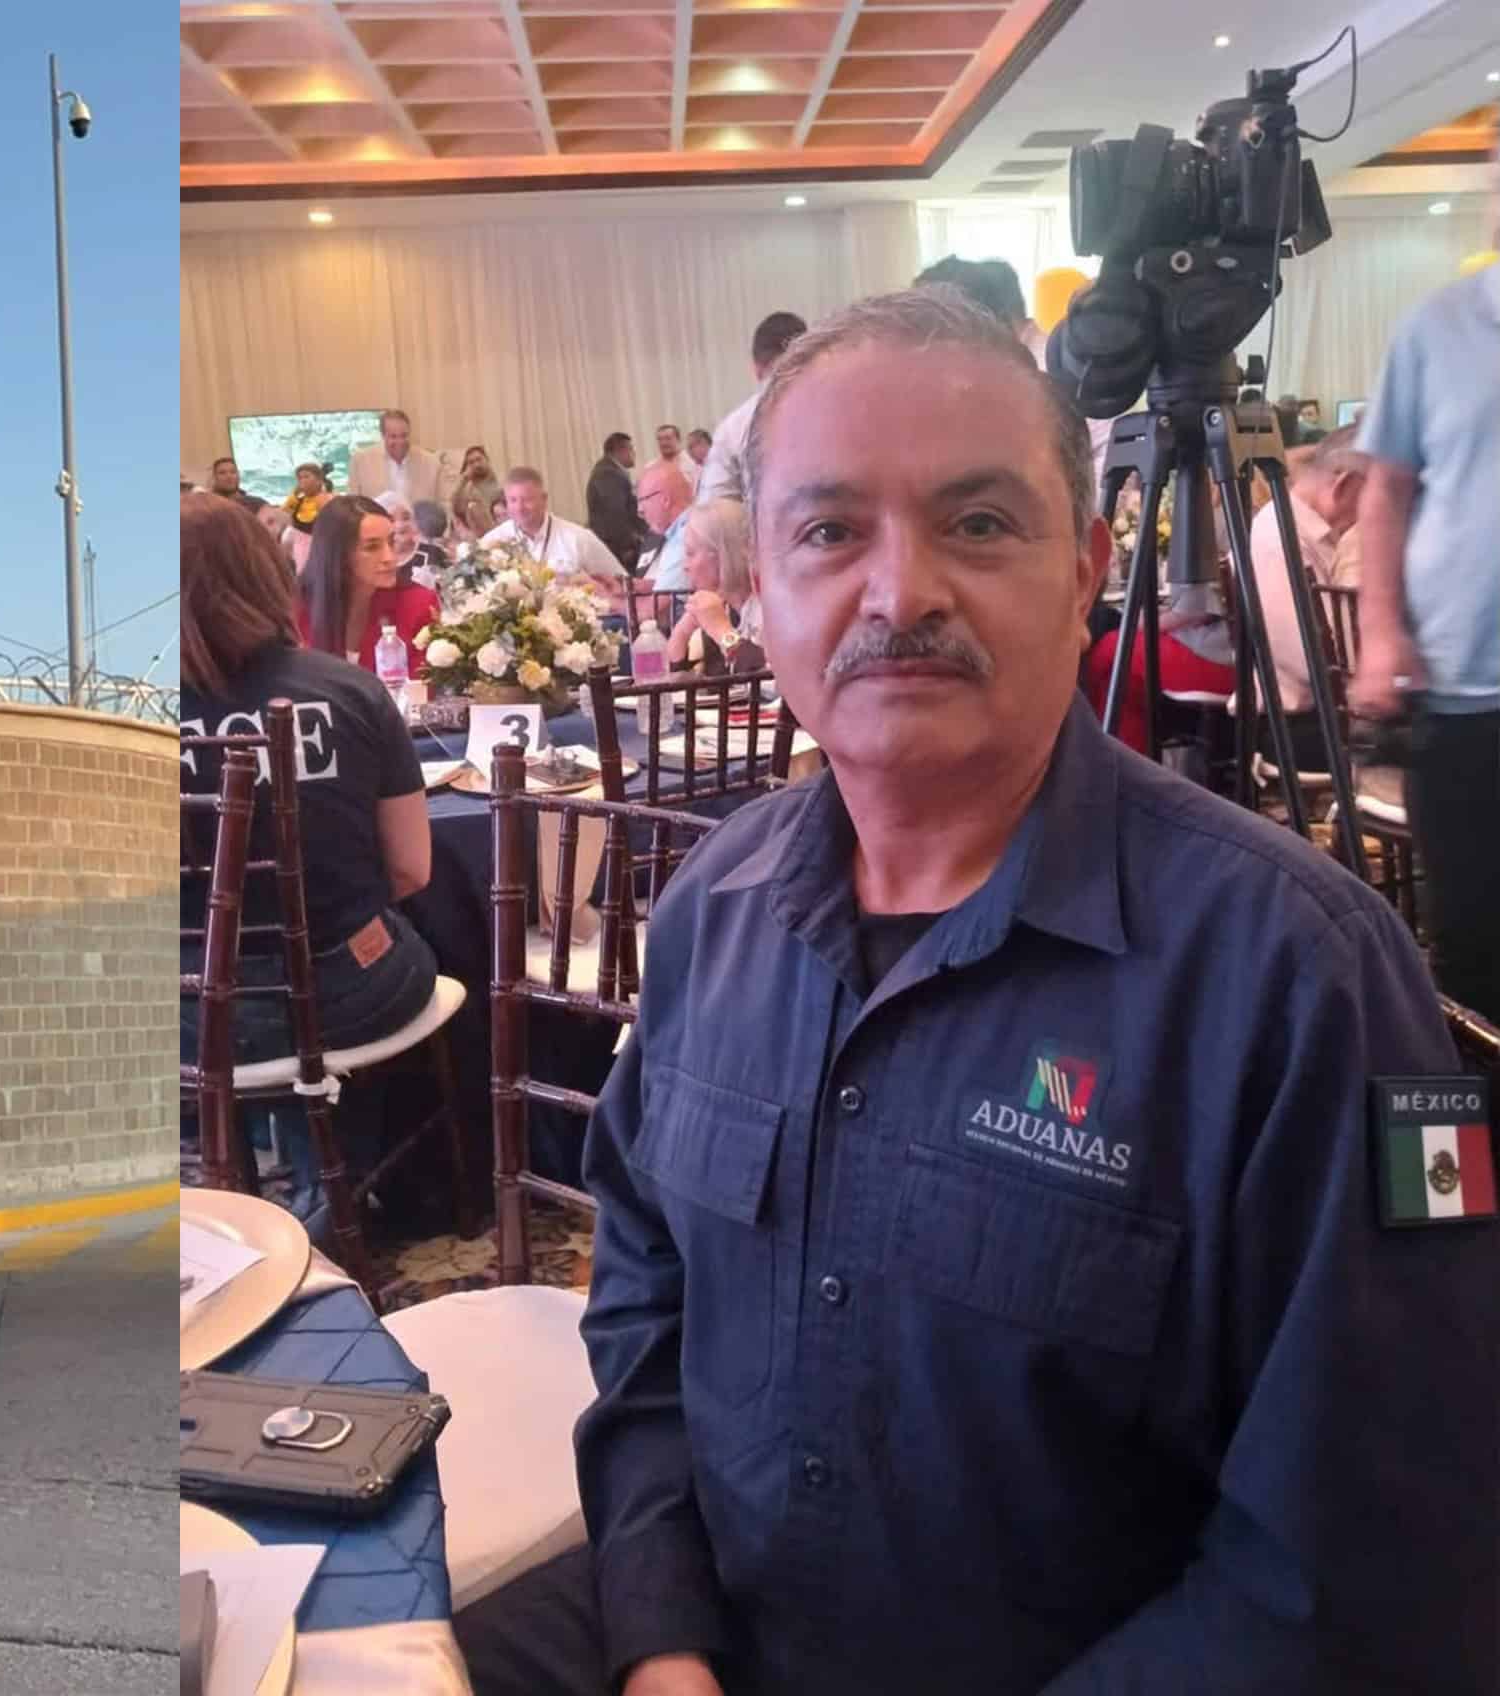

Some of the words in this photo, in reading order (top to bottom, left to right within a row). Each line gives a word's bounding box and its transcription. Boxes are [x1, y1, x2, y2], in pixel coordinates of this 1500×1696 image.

[500, 714, 530, 748] 3
[1392, 1091, 1481, 1112] MÉXICO
[971, 1100, 1132, 1171] ADUANAS
